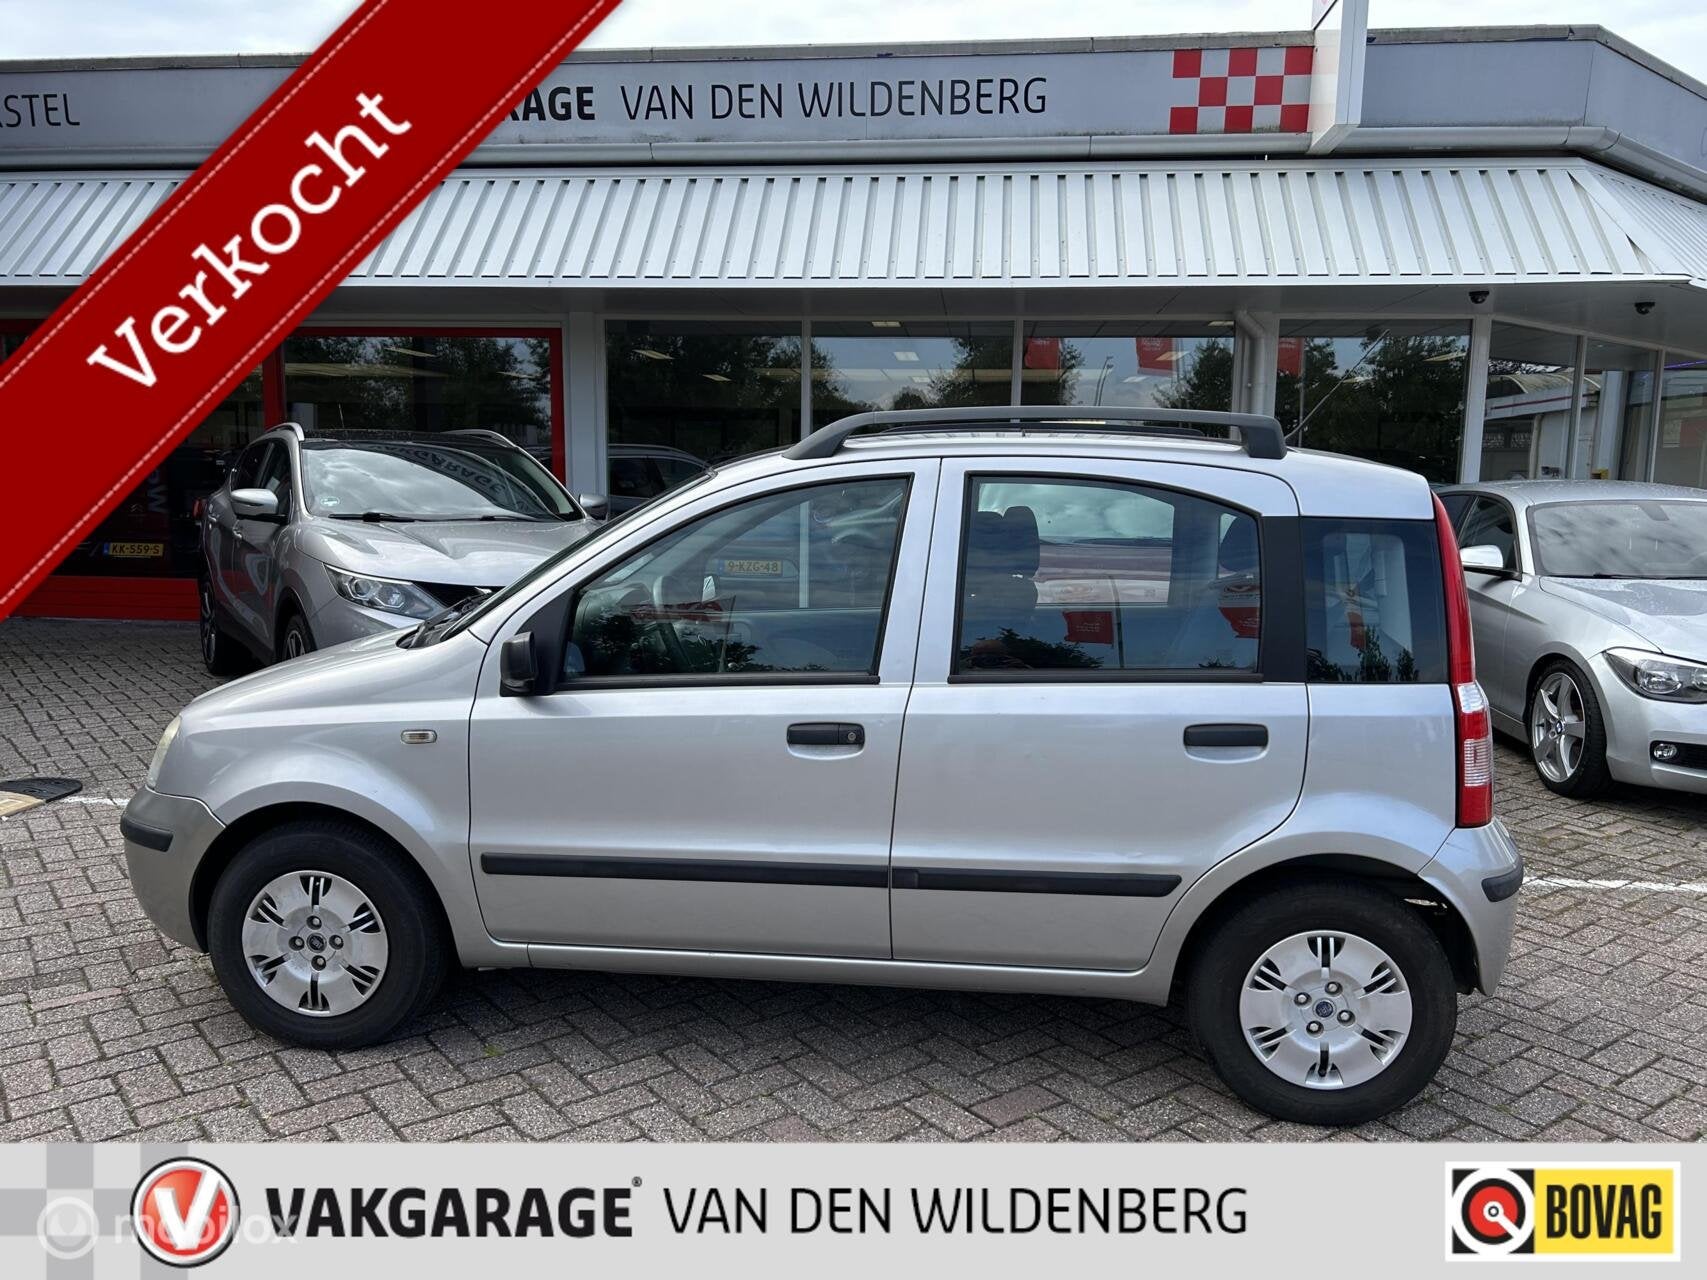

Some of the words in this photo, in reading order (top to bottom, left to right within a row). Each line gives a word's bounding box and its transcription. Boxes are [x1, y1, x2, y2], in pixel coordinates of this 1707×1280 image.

[0, 93, 81, 128] STEL
[620, 84, 694, 120] VAN
[711, 83, 783, 120] DEN
[797, 77, 1048, 118] WILDENBERG
[727, 560, 779, 573] 9-KZG-48
